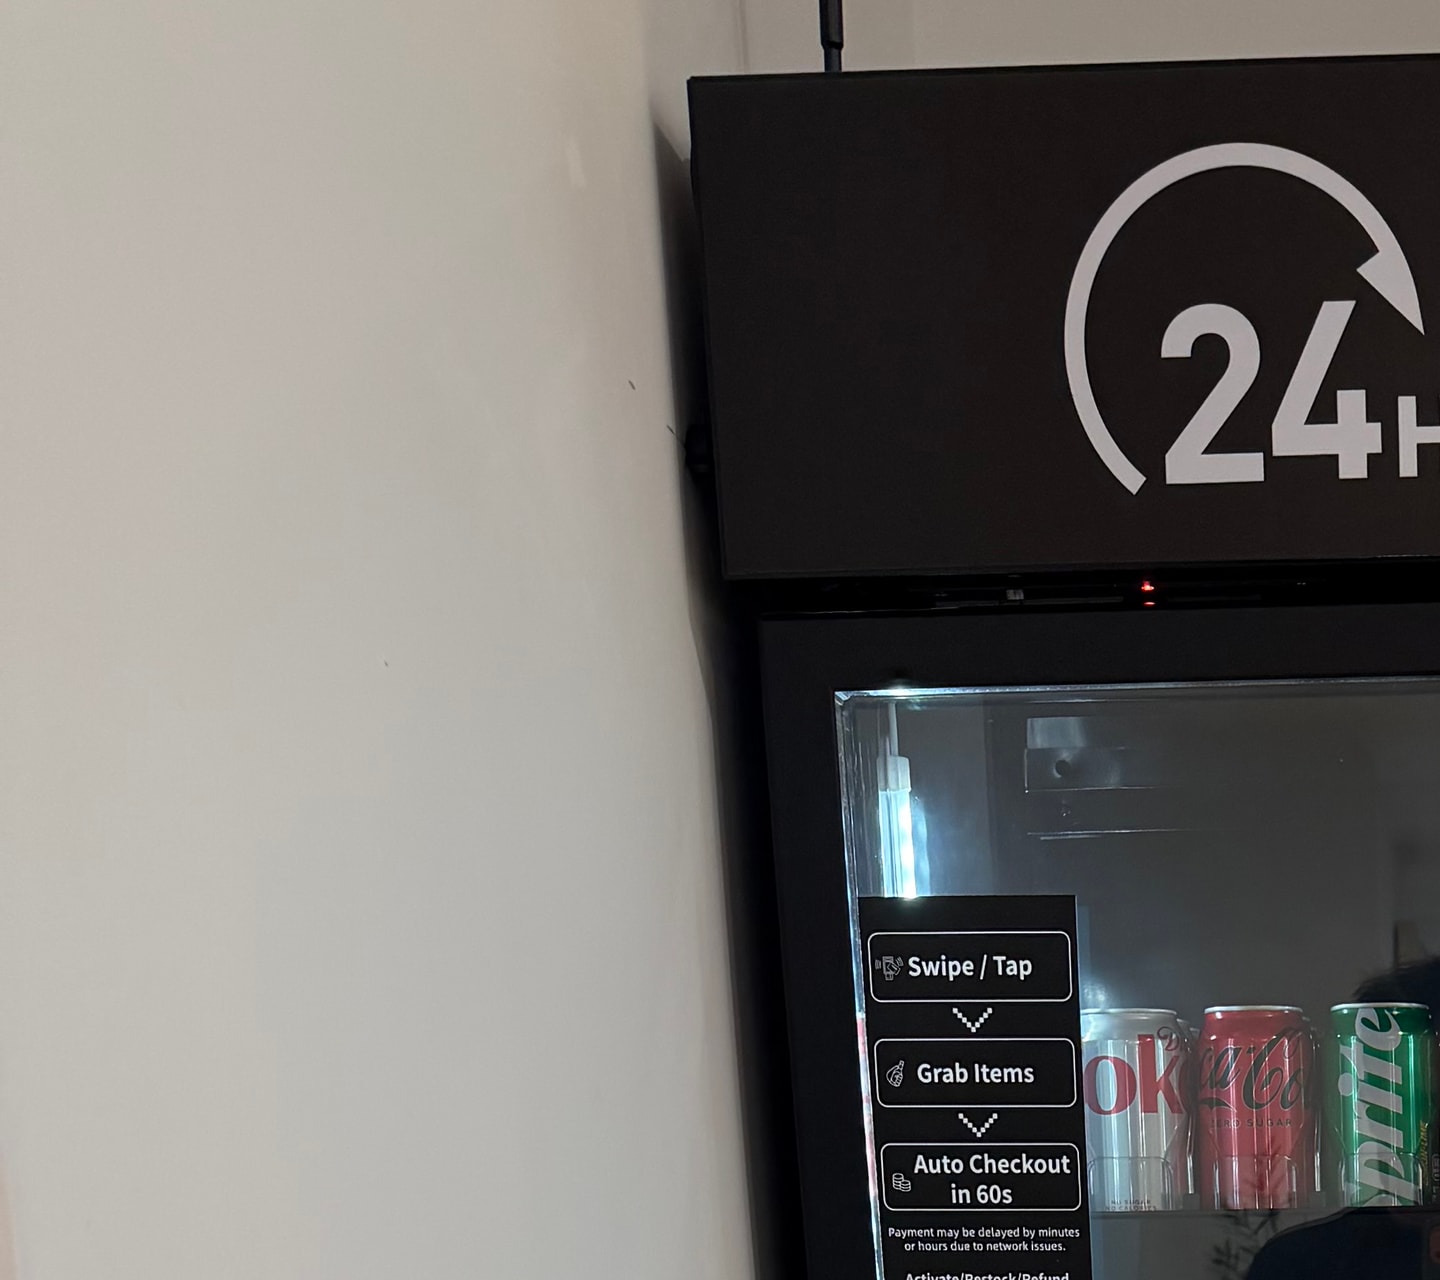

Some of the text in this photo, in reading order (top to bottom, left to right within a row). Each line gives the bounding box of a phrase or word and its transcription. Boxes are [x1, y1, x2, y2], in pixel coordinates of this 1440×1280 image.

[907, 954, 1033, 982] Swipe / Tap
[916, 1062, 1035, 1084] Grab Items
[913, 1153, 1072, 1175] Auto Checkout
[950, 1183, 1013, 1205] in 60s
[888, 1226, 1080, 1240] Payment may be delayed by minutes
[904, 1240, 1067, 1251] or hours due to network issues.
